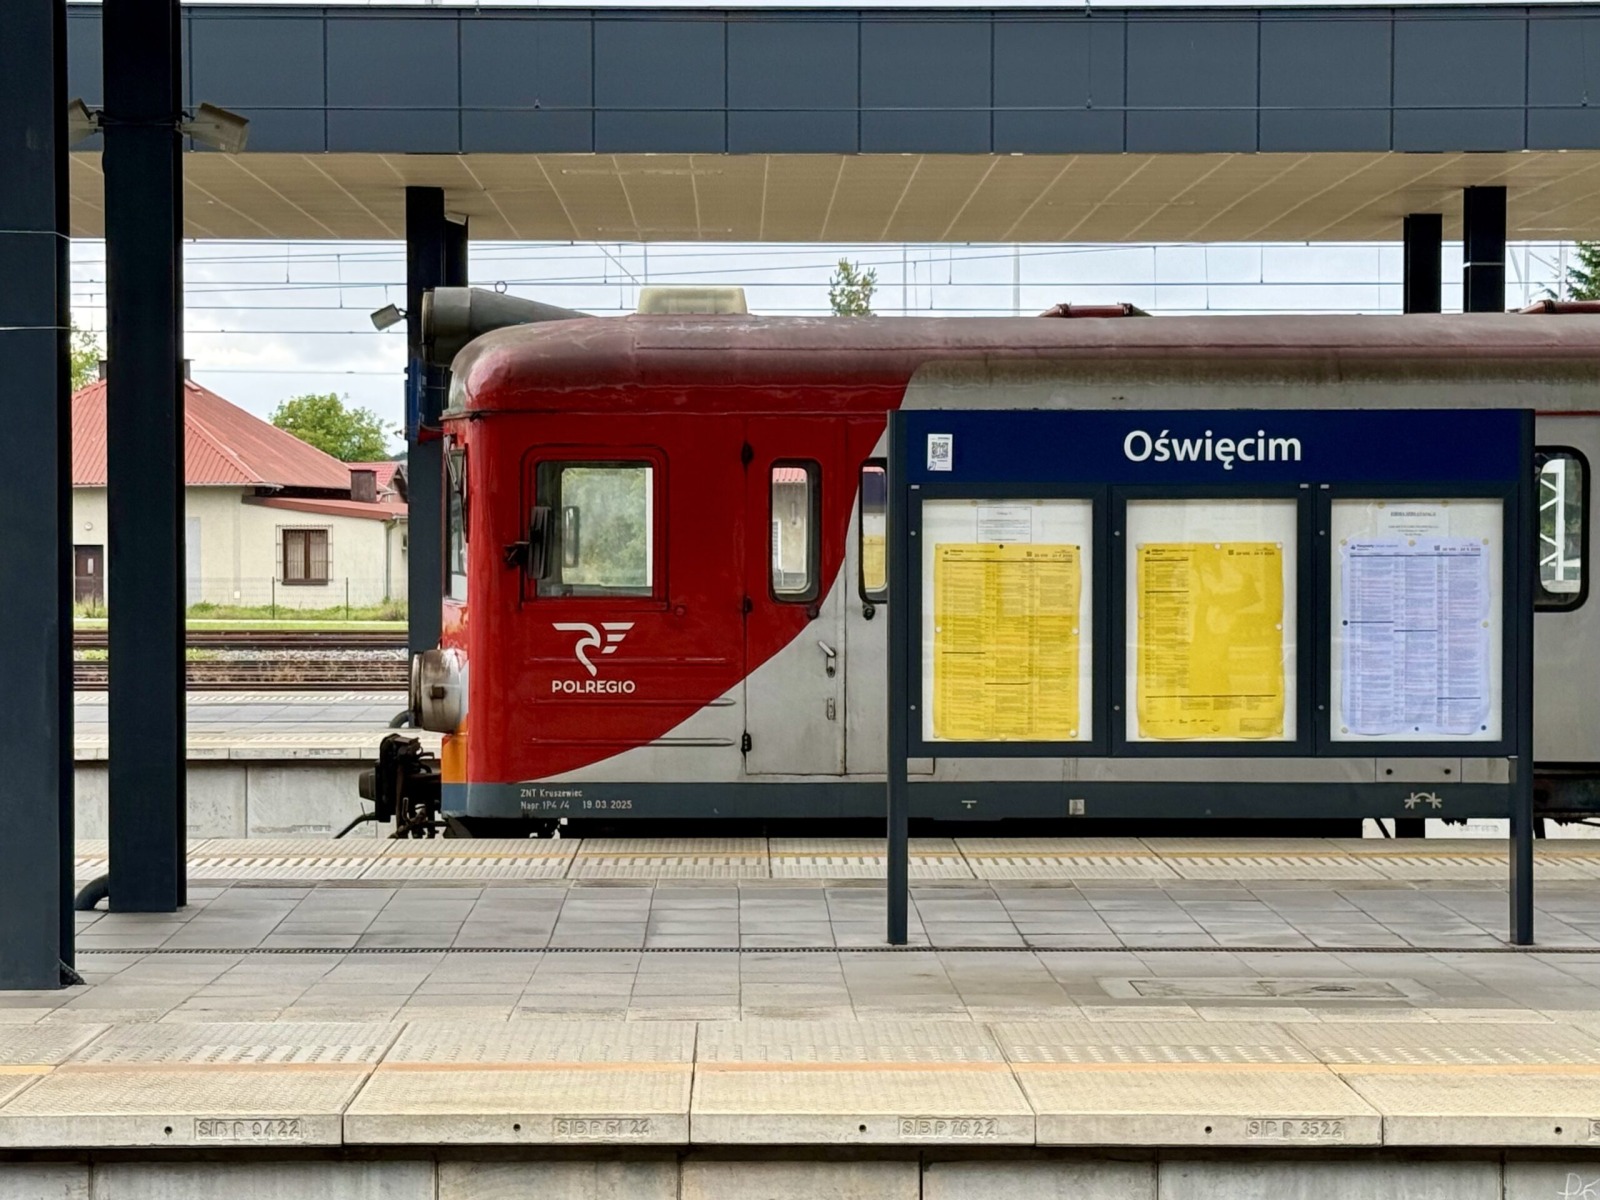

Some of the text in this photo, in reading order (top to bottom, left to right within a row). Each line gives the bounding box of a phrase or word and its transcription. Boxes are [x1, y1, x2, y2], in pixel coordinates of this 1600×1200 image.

[1123, 429, 1302, 470] Oświęcim
[551, 680, 636, 694] POLREGIO
[520, 788, 537, 798] ZNT
